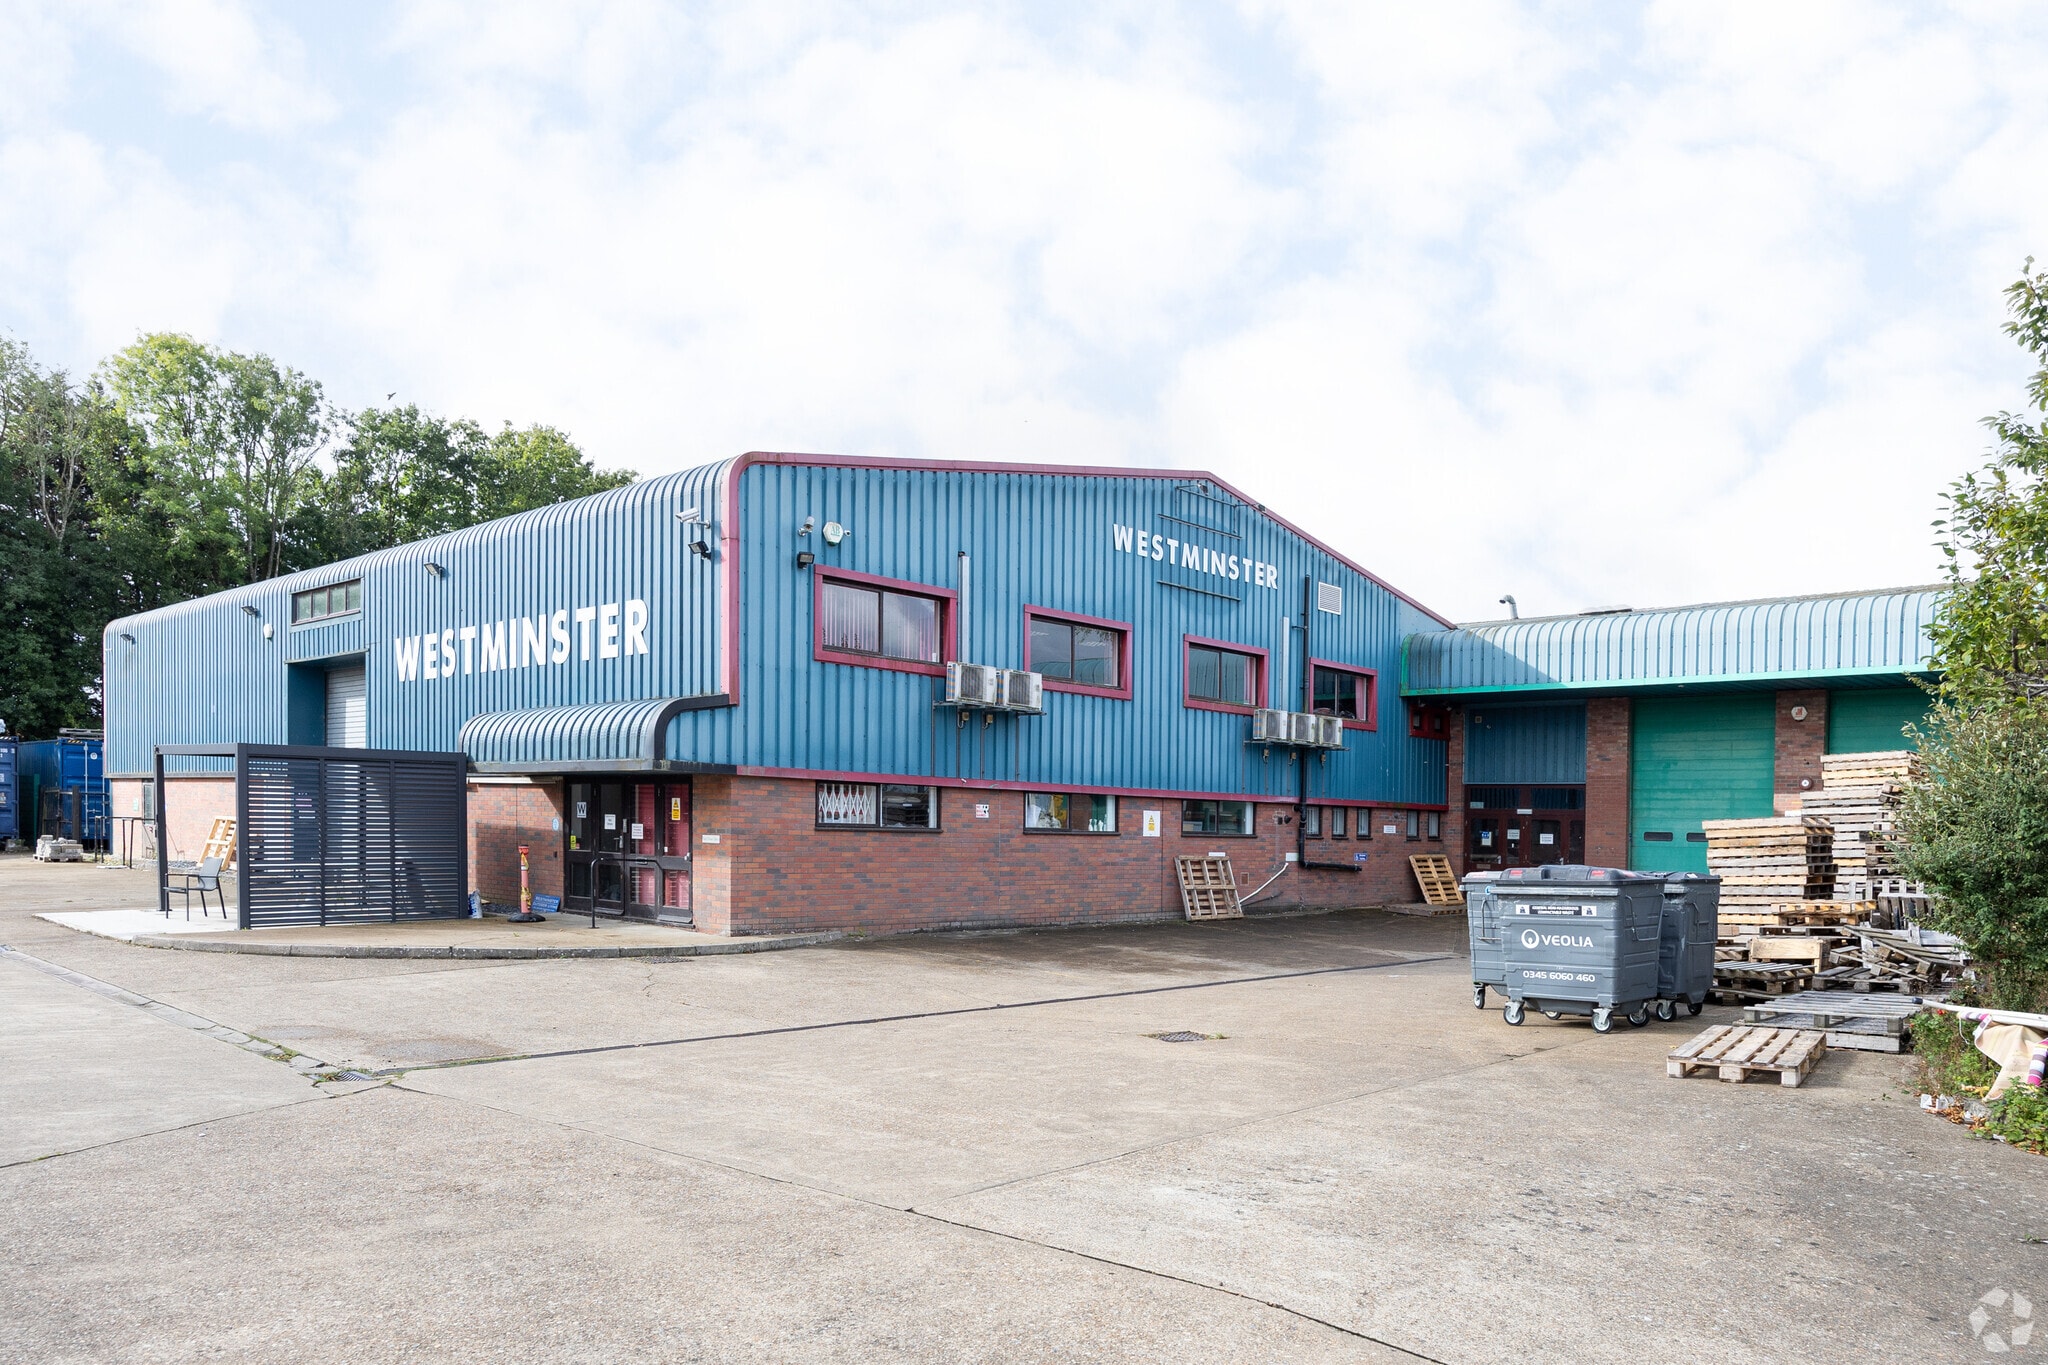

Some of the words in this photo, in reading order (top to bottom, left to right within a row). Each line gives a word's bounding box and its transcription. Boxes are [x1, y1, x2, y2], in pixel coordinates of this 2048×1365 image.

[1113, 523, 1278, 589] WESTMINSTER
[395, 598, 649, 682] WESTMINSTER
[577, 803, 586, 814] W
[1541, 934, 1594, 947] VEOLIA
[1522, 970, 1547, 979] 0345
[1549, 971, 1574, 981] 6060
[1575, 973, 1596, 982] 460
